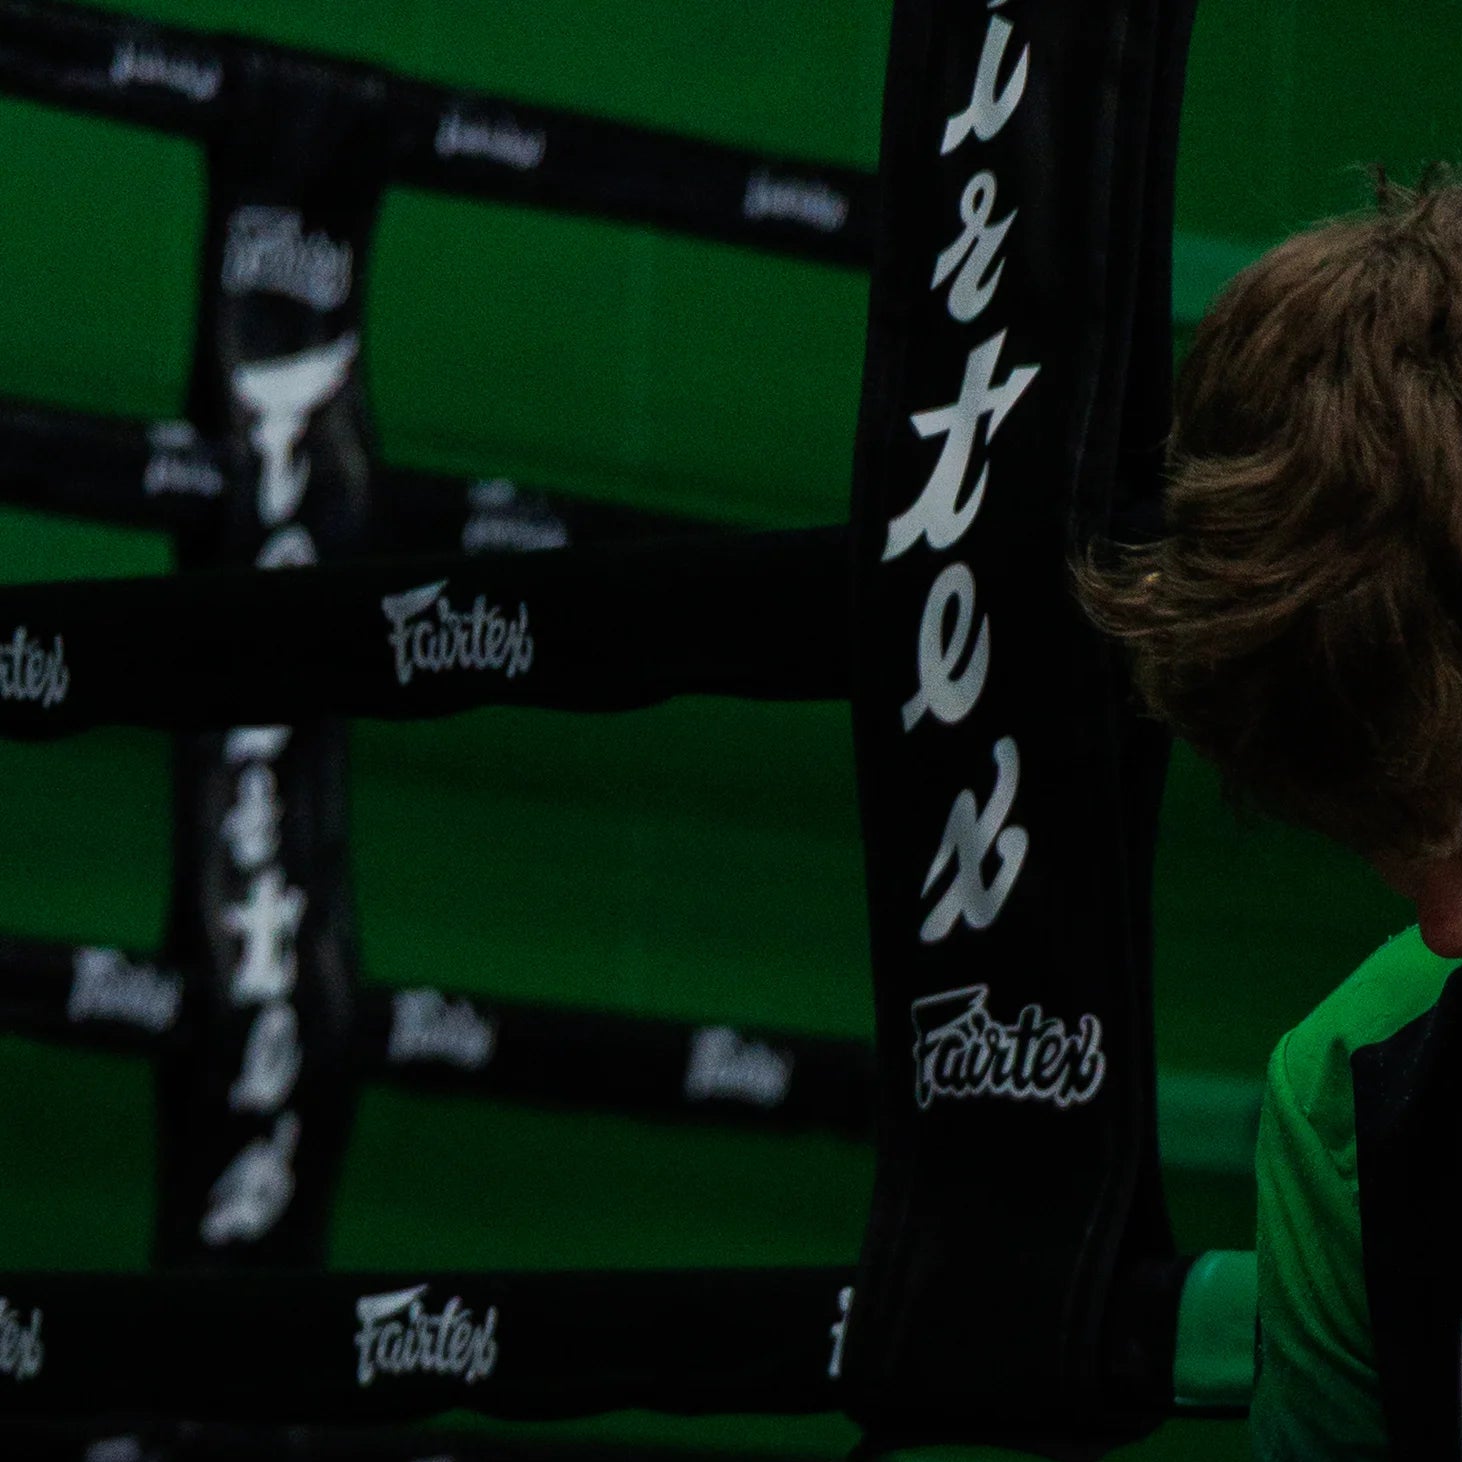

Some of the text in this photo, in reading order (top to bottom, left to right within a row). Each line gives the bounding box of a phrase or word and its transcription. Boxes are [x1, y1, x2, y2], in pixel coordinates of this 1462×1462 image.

[381, 579, 534, 686] Fairtex
[911, 982, 1107, 1110] Fairtex
[354, 1282, 499, 1386] Fairtex
